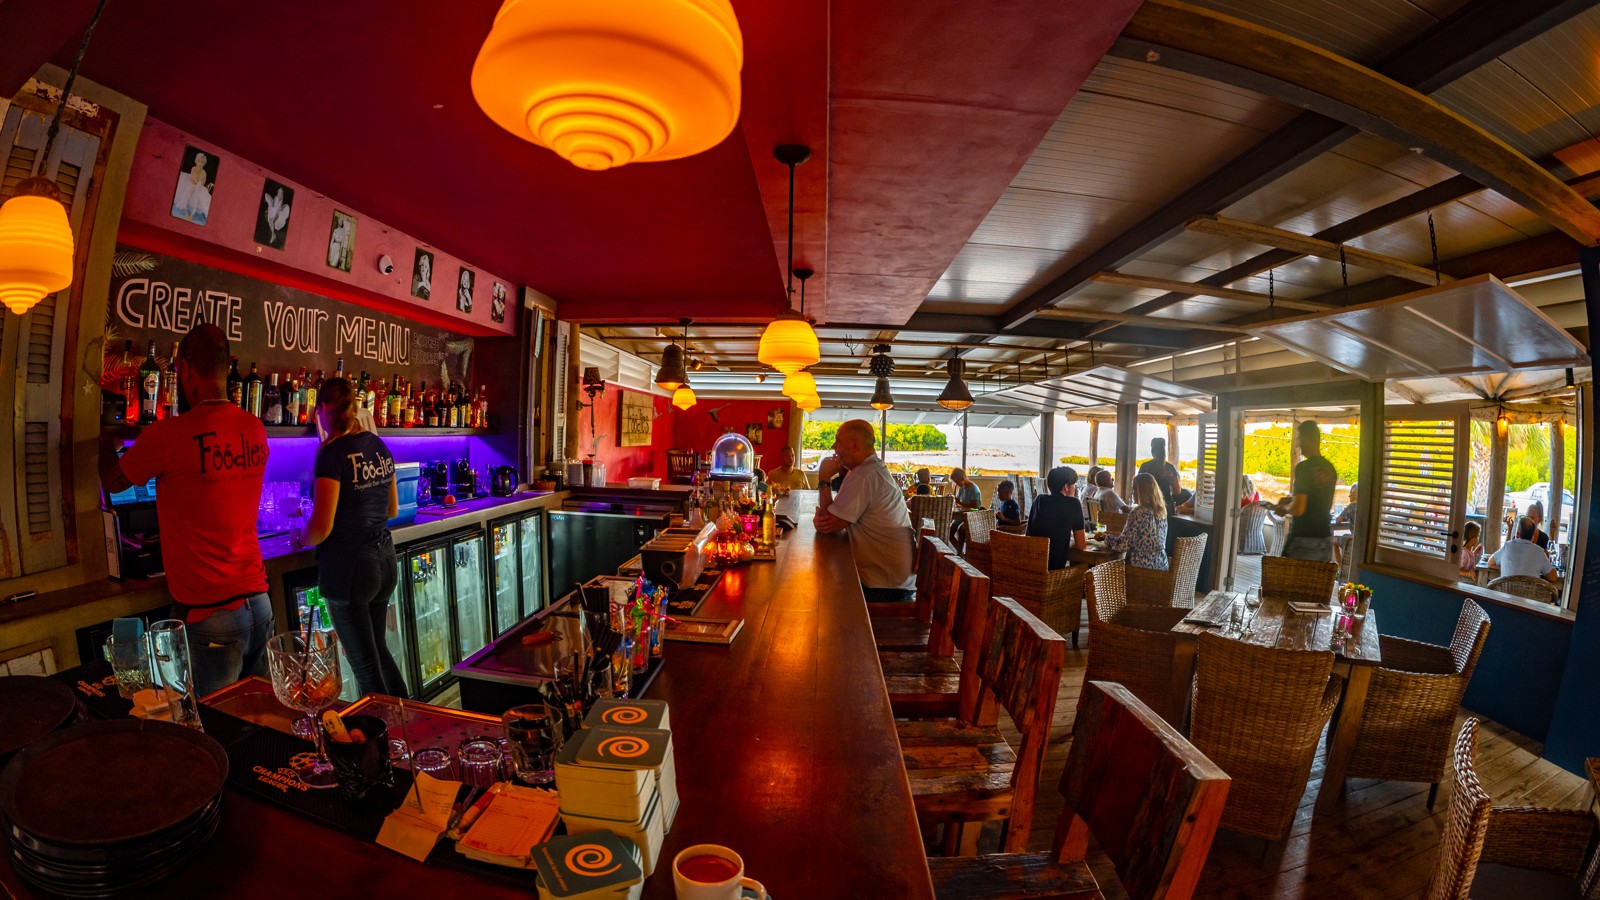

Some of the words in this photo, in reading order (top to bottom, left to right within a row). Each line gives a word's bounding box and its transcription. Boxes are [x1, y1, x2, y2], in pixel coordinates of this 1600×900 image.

[116, 278, 242, 342] CREATE
[335, 313, 411, 366] MENU
[252, 765, 310, 792] CHAMPIONS
